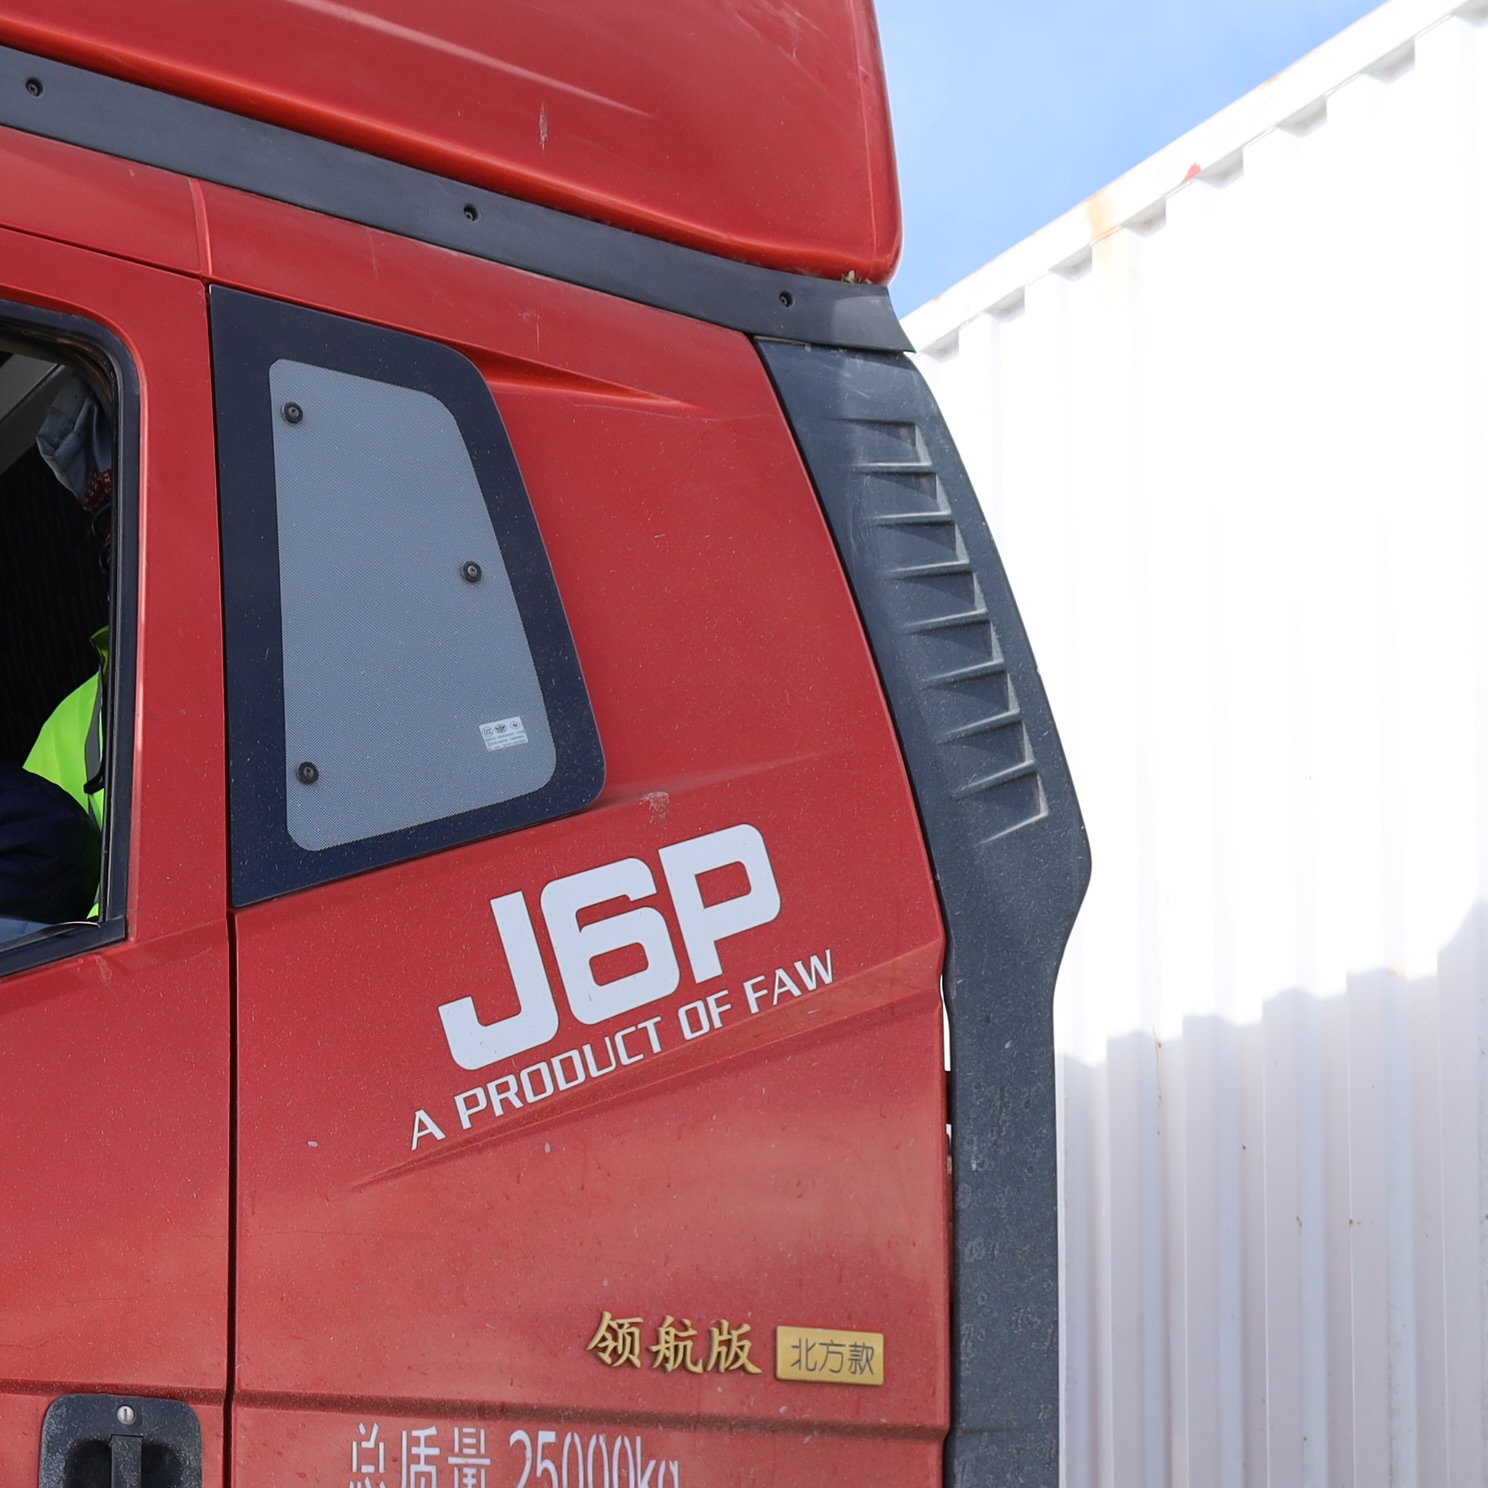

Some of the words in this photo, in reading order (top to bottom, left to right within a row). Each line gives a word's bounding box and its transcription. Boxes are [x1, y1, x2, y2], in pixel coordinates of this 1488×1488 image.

[438, 823, 781, 1070] J6P
[411, 1109, 446, 1150] A
[454, 1016, 662, 1130] PRODUCT
[678, 989, 732, 1041] OF
[743, 949, 834, 1014] FAW
[586, 1311, 762, 1375] 领航版
[790, 1337, 876, 1377] 北方款
